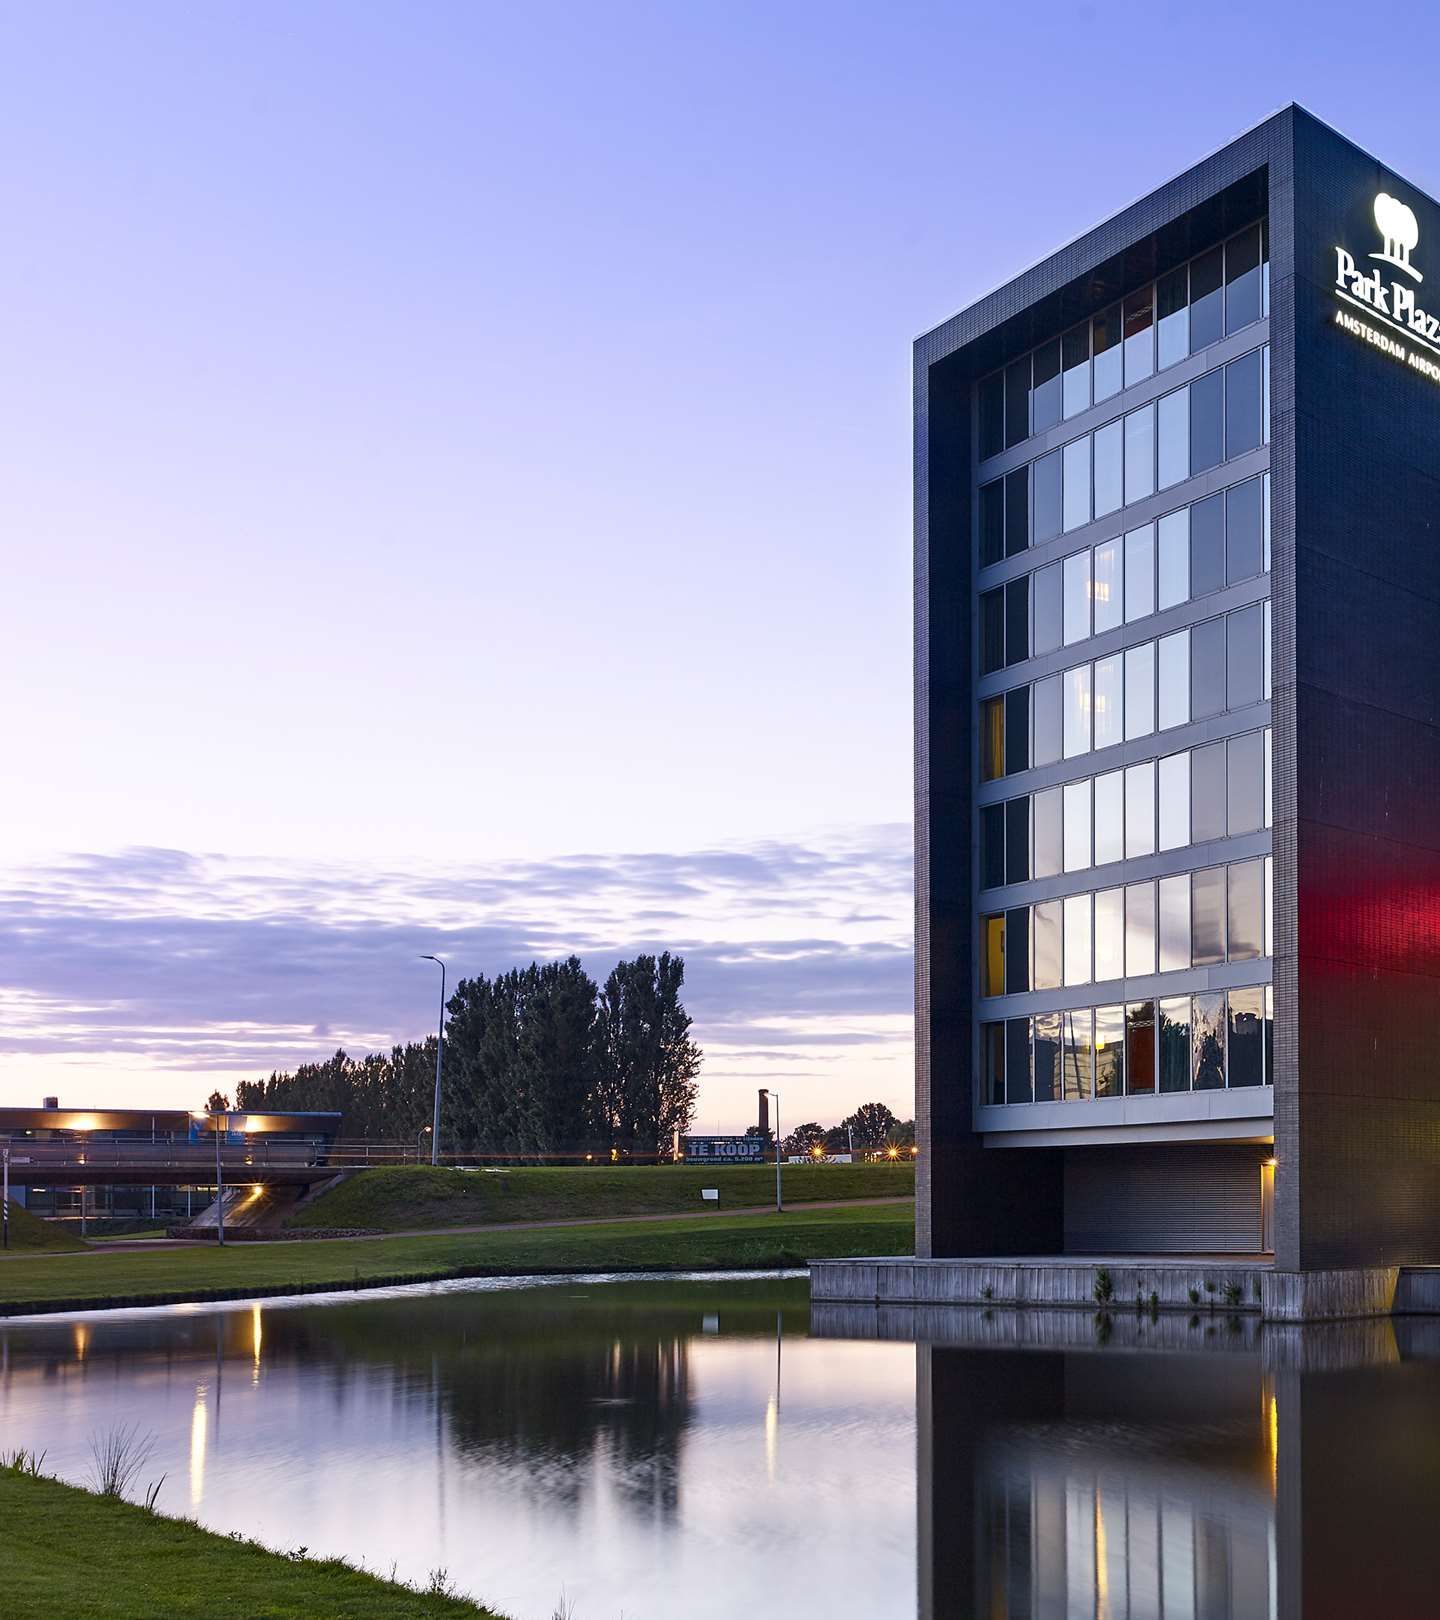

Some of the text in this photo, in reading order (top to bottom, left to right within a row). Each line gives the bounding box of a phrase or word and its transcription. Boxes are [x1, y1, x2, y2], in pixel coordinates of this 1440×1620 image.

[1335, 246, 1389, 315] Park
[1335, 310, 1405, 361] AMSTERDAM
[688, 1144, 760, 1156] TE KOOP
